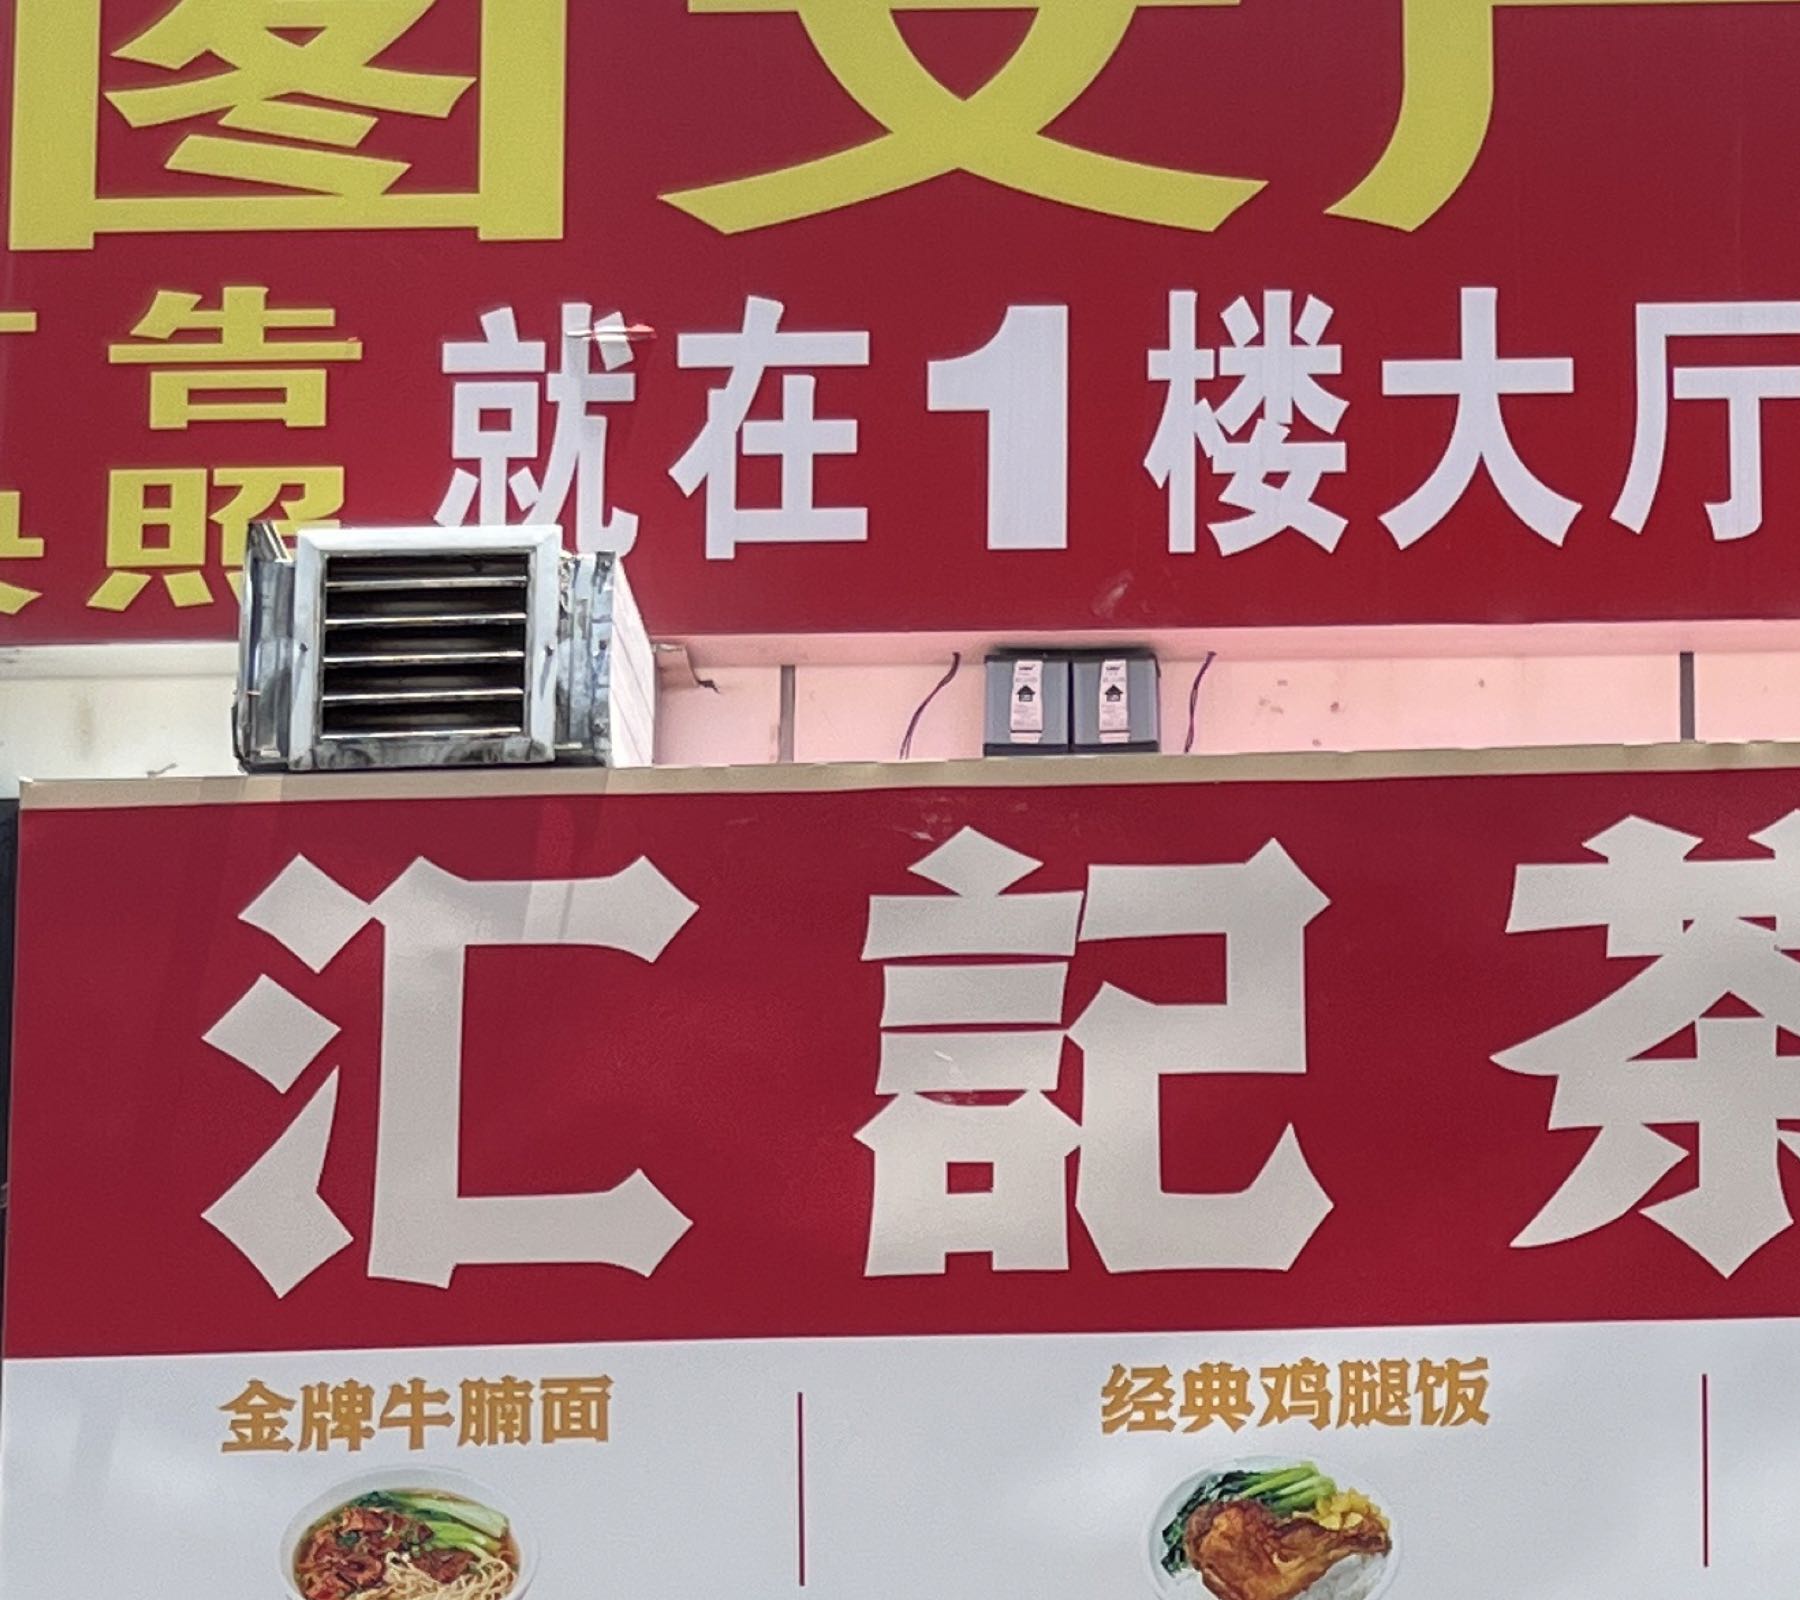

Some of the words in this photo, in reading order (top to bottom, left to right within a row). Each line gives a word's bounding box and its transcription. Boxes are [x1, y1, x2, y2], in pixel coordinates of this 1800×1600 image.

[220, 1374, 614, 1454] 金牌牛腩面
[1100, 1356, 1491, 1438] 经典鸡腿饭
